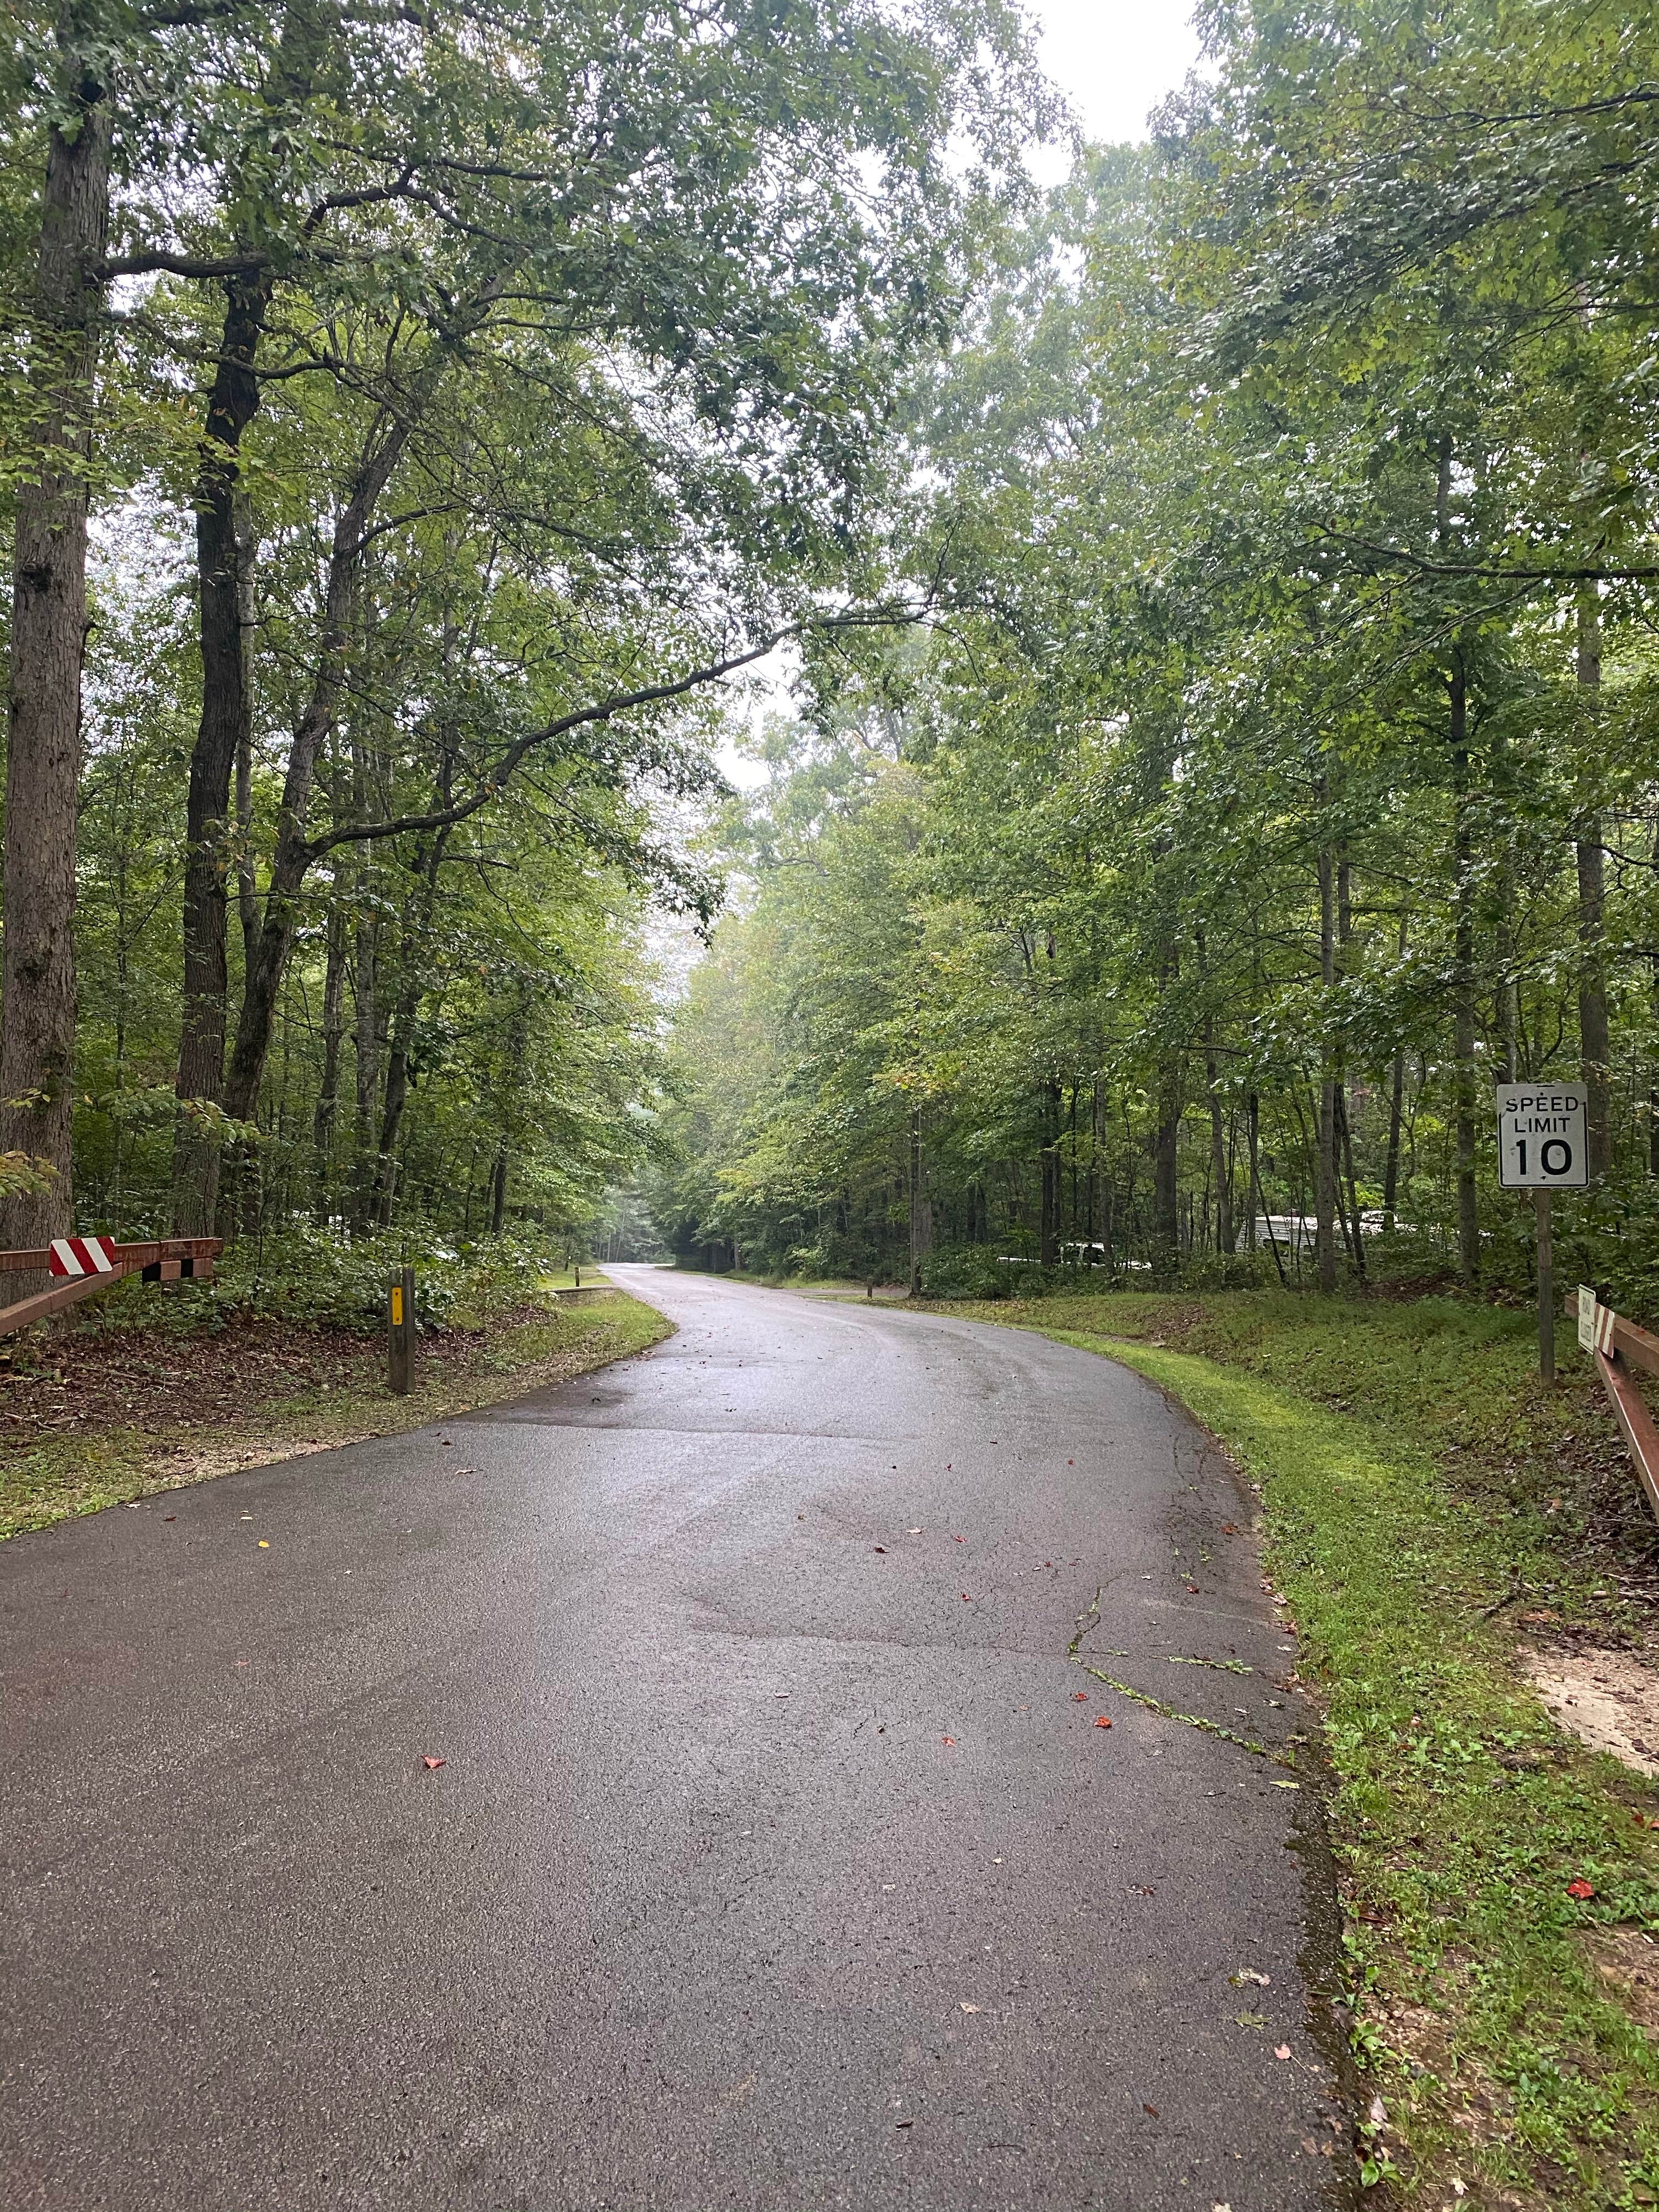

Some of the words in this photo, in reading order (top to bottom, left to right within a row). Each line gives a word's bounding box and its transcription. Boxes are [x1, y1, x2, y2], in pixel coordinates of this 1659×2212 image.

[1506, 1097, 1578, 1112] SPEED
[1515, 1118, 1571, 1132] LIMIT
[1516, 1139, 1572, 1175] 10
